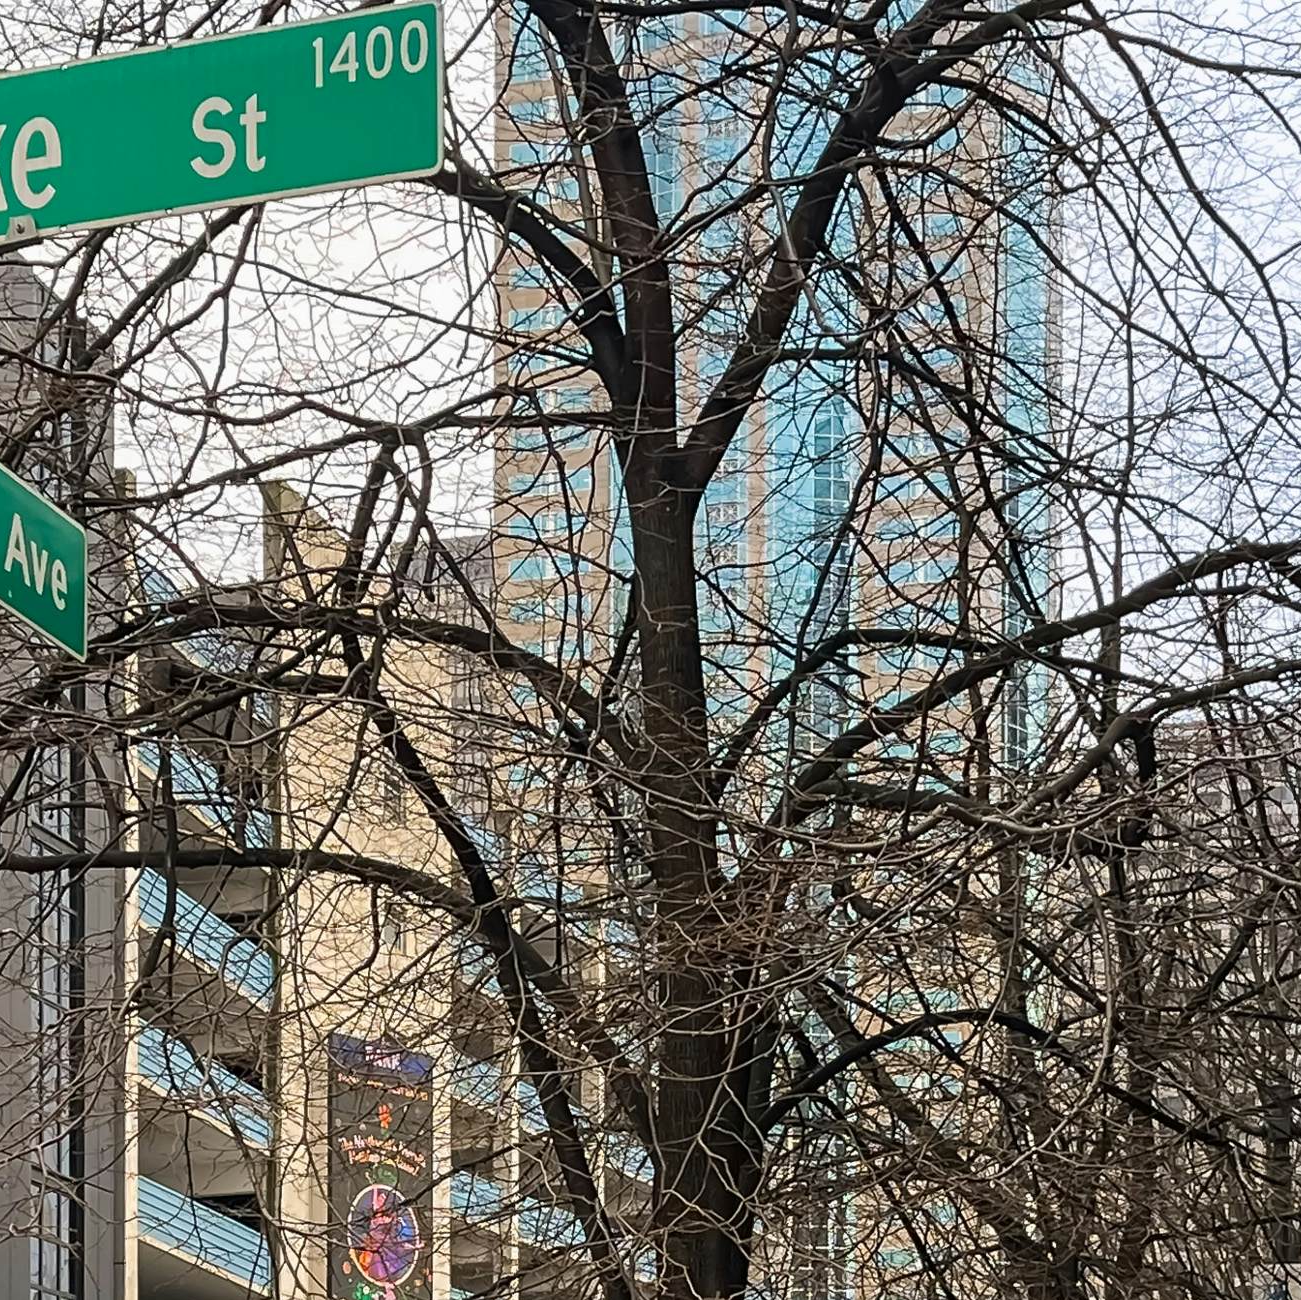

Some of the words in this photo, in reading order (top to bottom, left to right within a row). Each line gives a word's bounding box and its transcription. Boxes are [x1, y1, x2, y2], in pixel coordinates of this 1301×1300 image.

[311, 20, 429, 88] 1400
[191, 93, 267, 179] St
[3, 512, 67, 610] Ave
